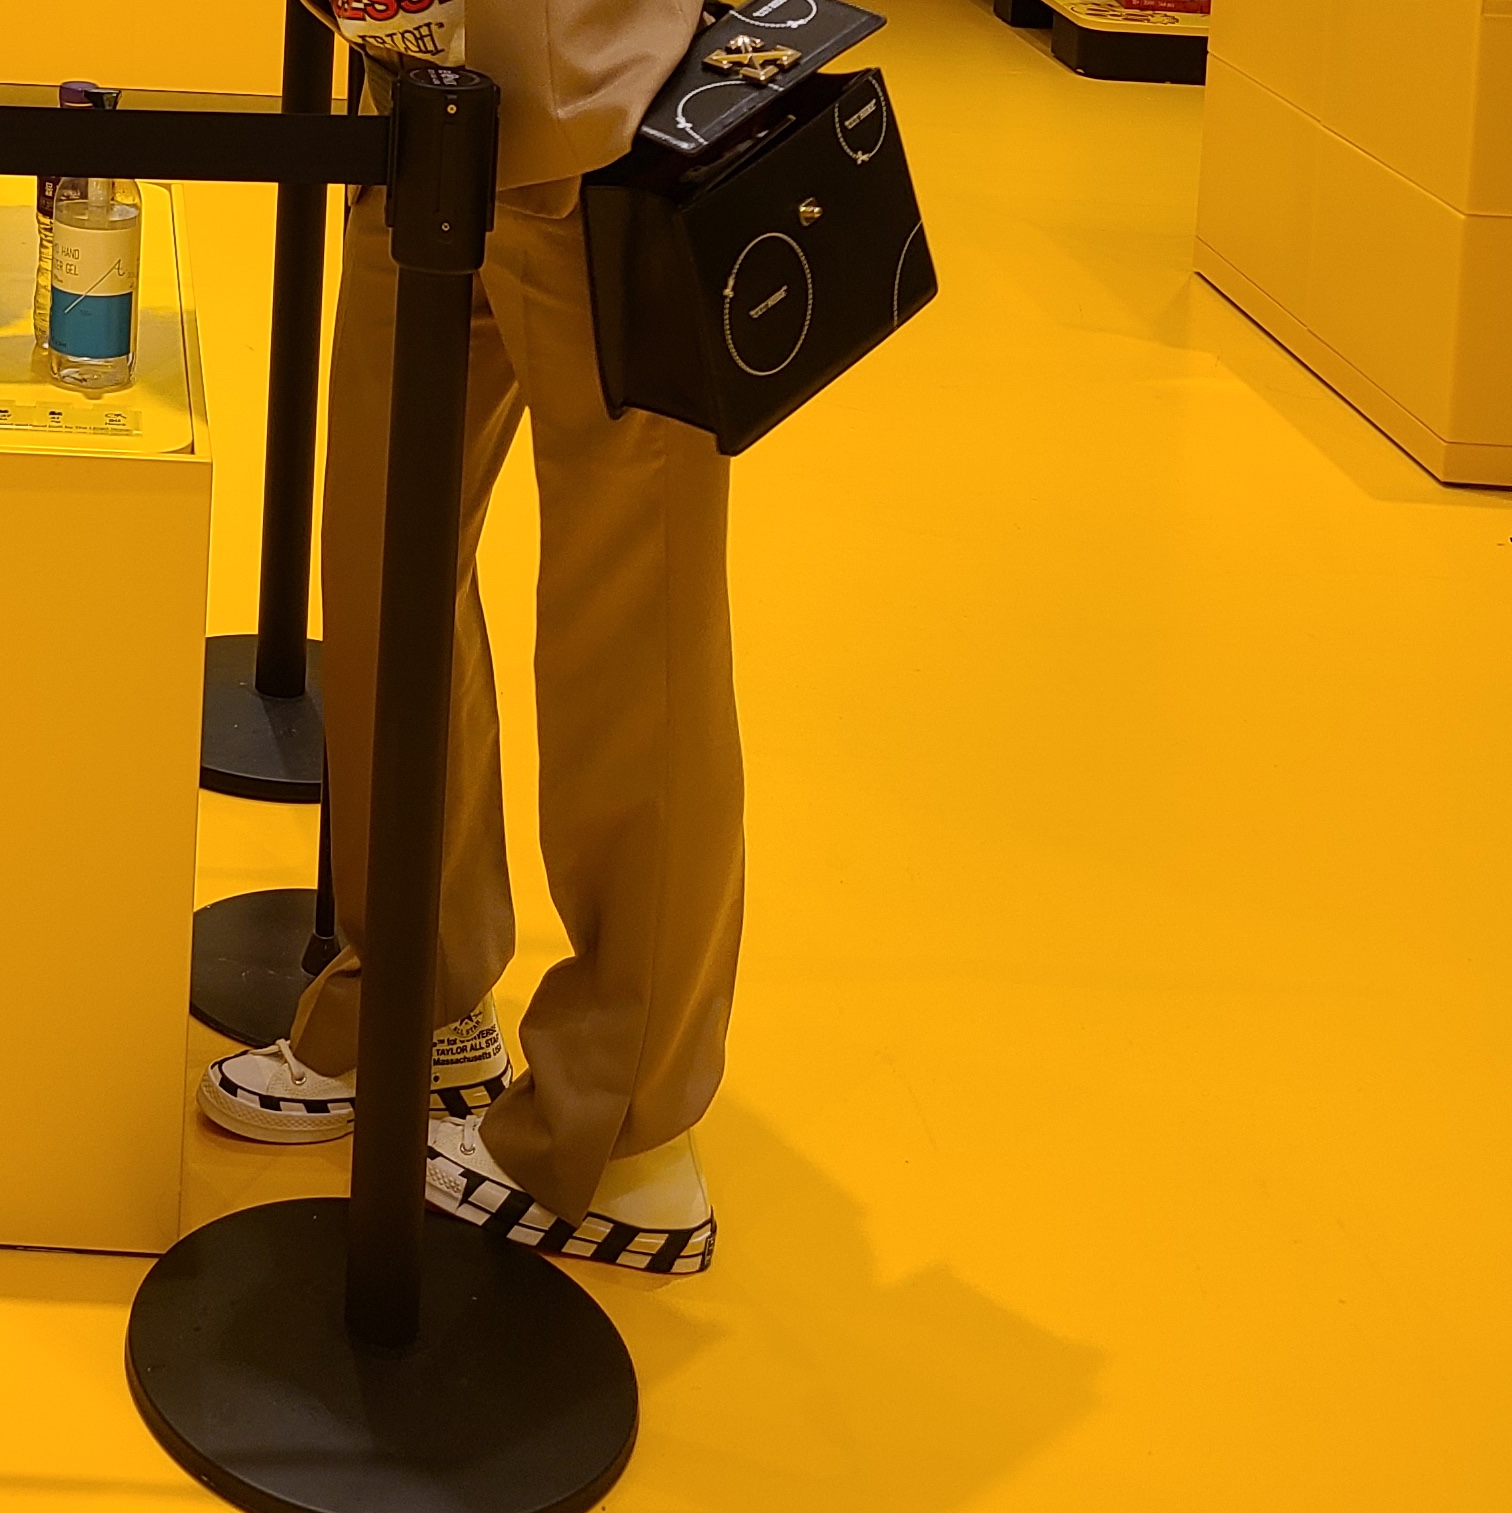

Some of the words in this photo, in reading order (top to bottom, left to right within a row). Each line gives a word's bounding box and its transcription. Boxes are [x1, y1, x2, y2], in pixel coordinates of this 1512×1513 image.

[61, 246, 80, 260] HAND
[65, 262, 80, 277] GEL
[435, 1044, 468, 1056] TAYLOR
[469, 1040, 484, 1052] ALL
[433, 1051, 492, 1066] Massachusetts
